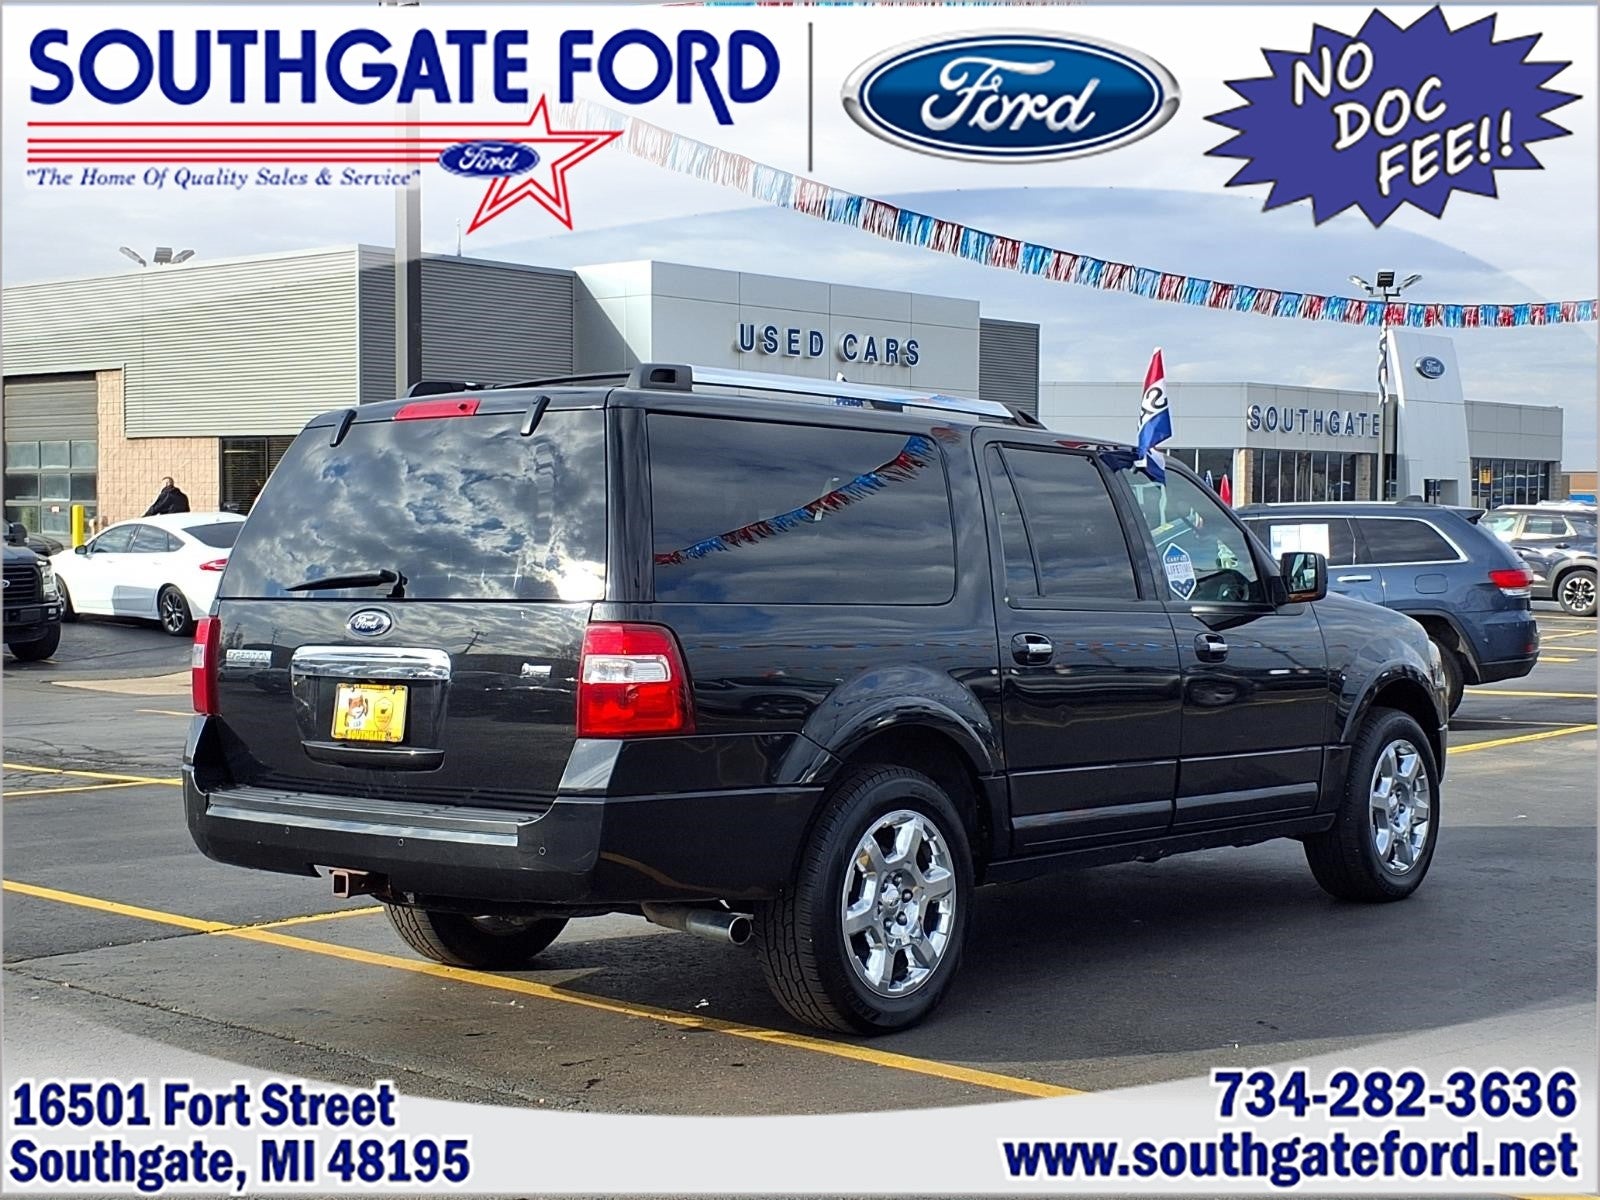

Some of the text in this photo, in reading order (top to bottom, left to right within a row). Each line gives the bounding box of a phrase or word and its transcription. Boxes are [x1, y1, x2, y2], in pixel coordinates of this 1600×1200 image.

[739, 322, 920, 366] USED CARS
[1249, 404, 1380, 438] SOUTHGATE
